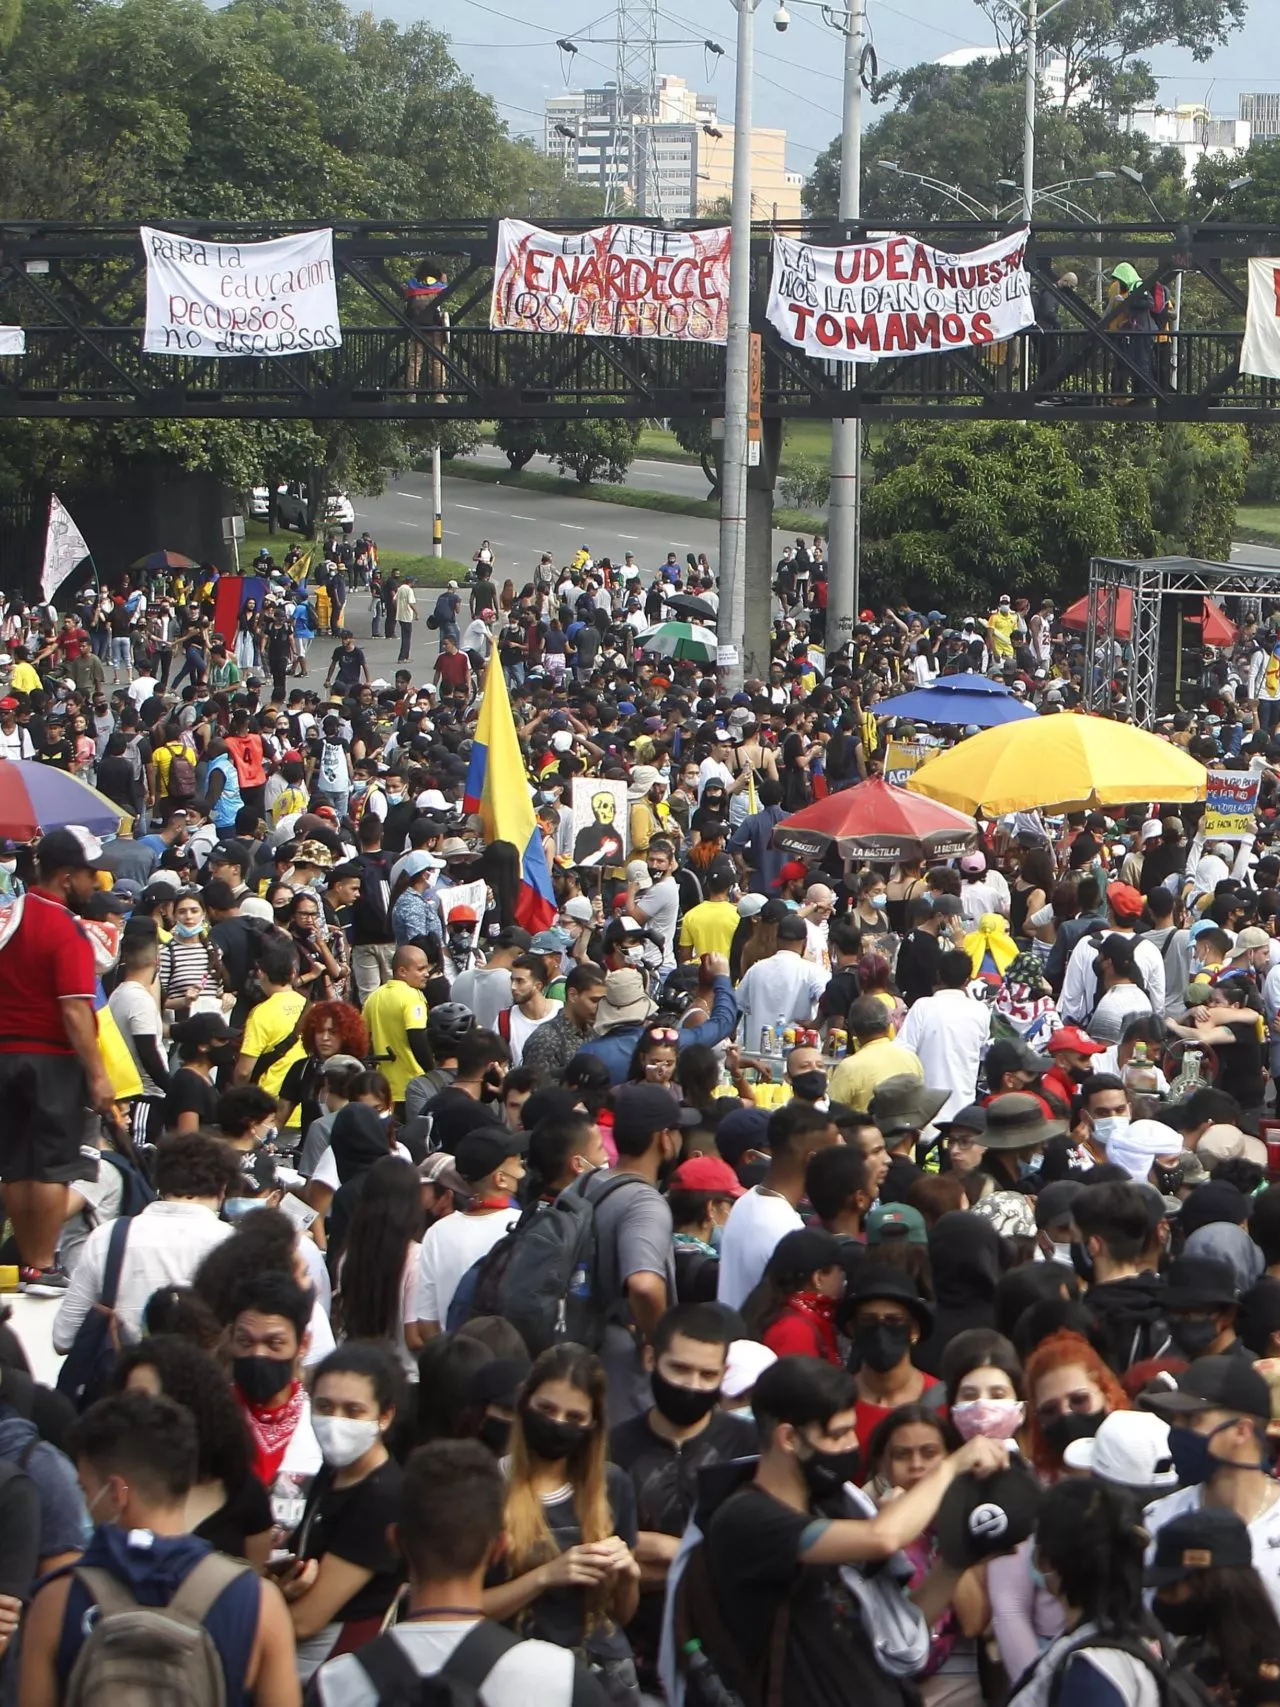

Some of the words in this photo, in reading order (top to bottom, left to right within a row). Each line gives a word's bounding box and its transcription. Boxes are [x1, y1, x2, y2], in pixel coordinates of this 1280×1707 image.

[607, 226, 682, 257] ARTE
[524, 249, 727, 300] ENARDECE
[778, 238, 816, 281] LA
[835, 238, 933, 284] UDEA
[779, 269, 818, 307] NOS
[824, 286, 857, 313] LA
[861, 282, 920, 314] DAN
[924, 286, 946, 313] O
[955, 282, 1001, 314] NOS
[1006, 270, 1029, 302] LA
[503, 282, 563, 332] LOS
[569, 296, 713, 340] PUEBLOS
[788, 303, 994, 351] TOMAMOS
[1234, 817, 1250, 830] TOD
[781, 838, 791, 848] LA
[791, 841, 821, 853] BASTILLA
[852, 847, 864, 857] LA
[865, 847, 901, 857] BASTILLA
[934, 844, 942, 854] LA
[942, 842, 966, 853] BASTILLA
